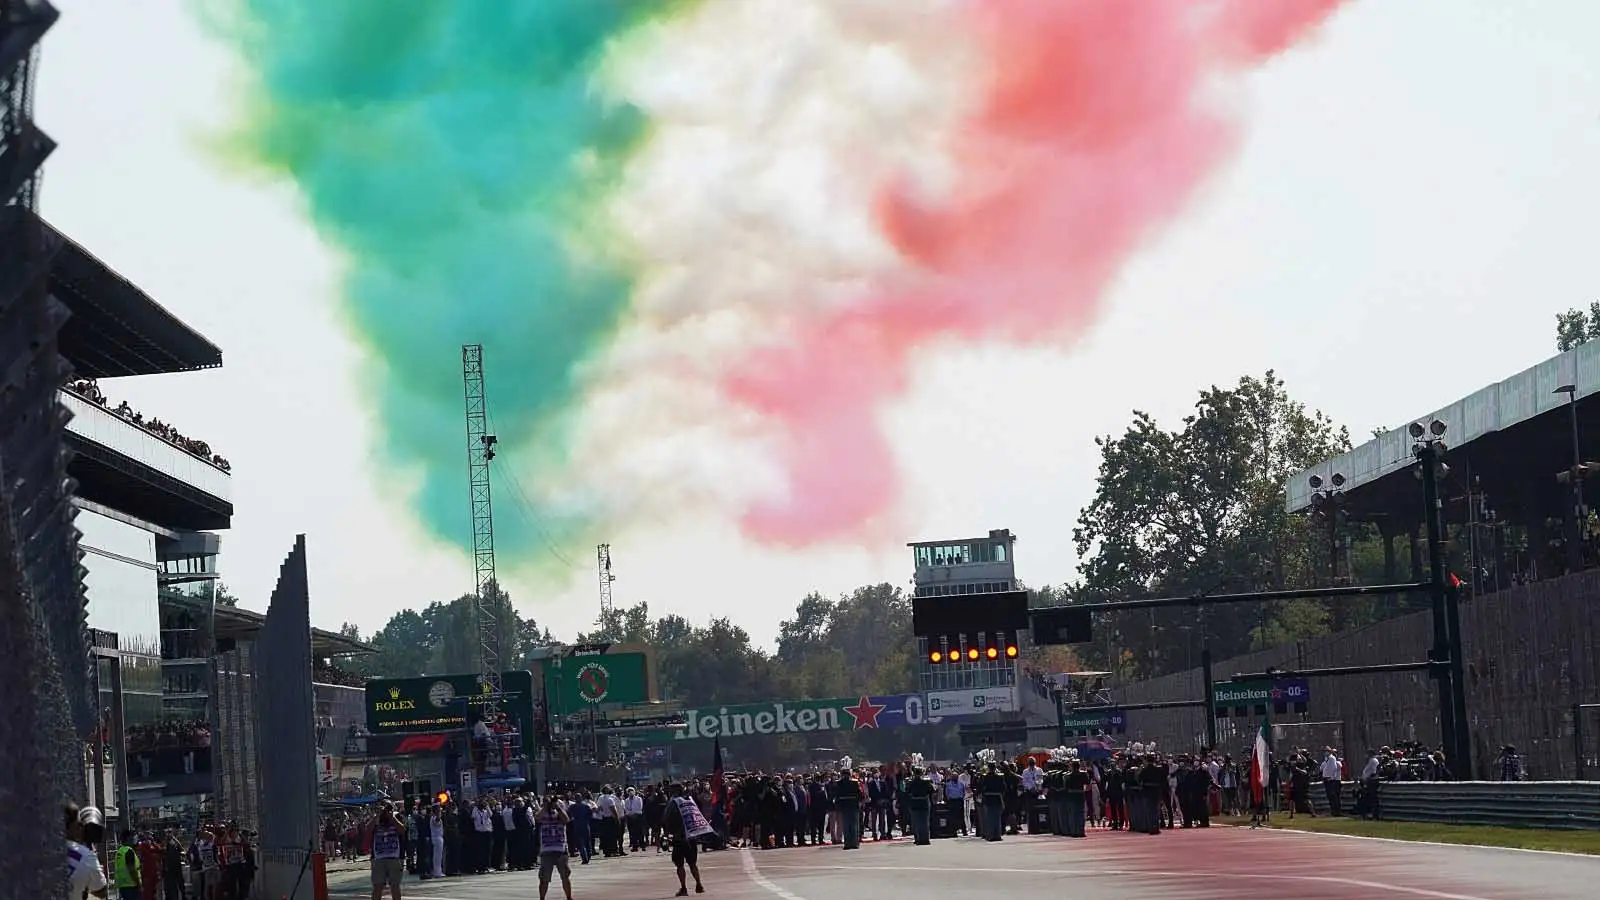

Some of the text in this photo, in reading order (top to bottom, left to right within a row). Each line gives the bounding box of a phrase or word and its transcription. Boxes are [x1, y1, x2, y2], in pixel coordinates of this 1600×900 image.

[1216, 689, 1268, 701] Heineken
[375, 699, 416, 711] ROLEX
[674, 703, 840, 740] Heineken
